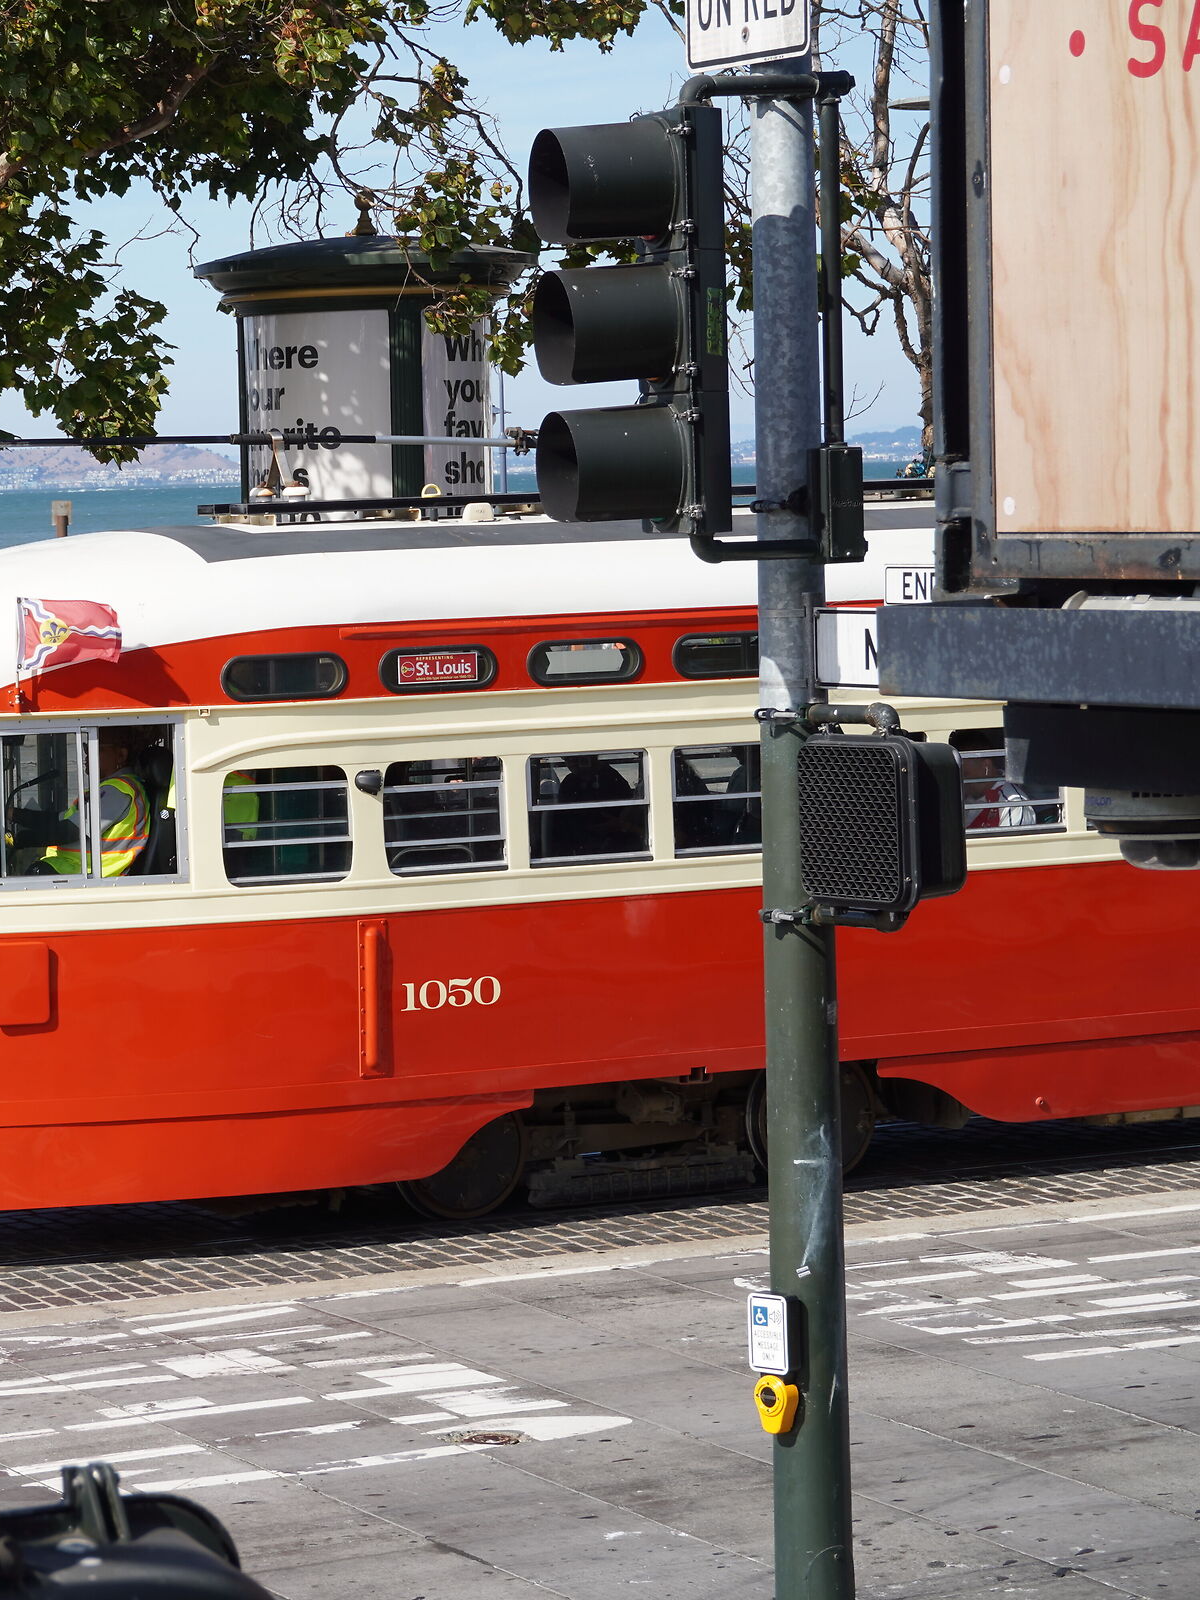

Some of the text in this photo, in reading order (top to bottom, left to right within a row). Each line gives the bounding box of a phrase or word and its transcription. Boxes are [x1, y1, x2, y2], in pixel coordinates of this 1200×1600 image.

[249, 338, 319, 371] here
[415, 659, 471, 676] St. Louis
[400, 975, 501, 1011] 1050
[762, 1352, 775, 1361] ONLY
